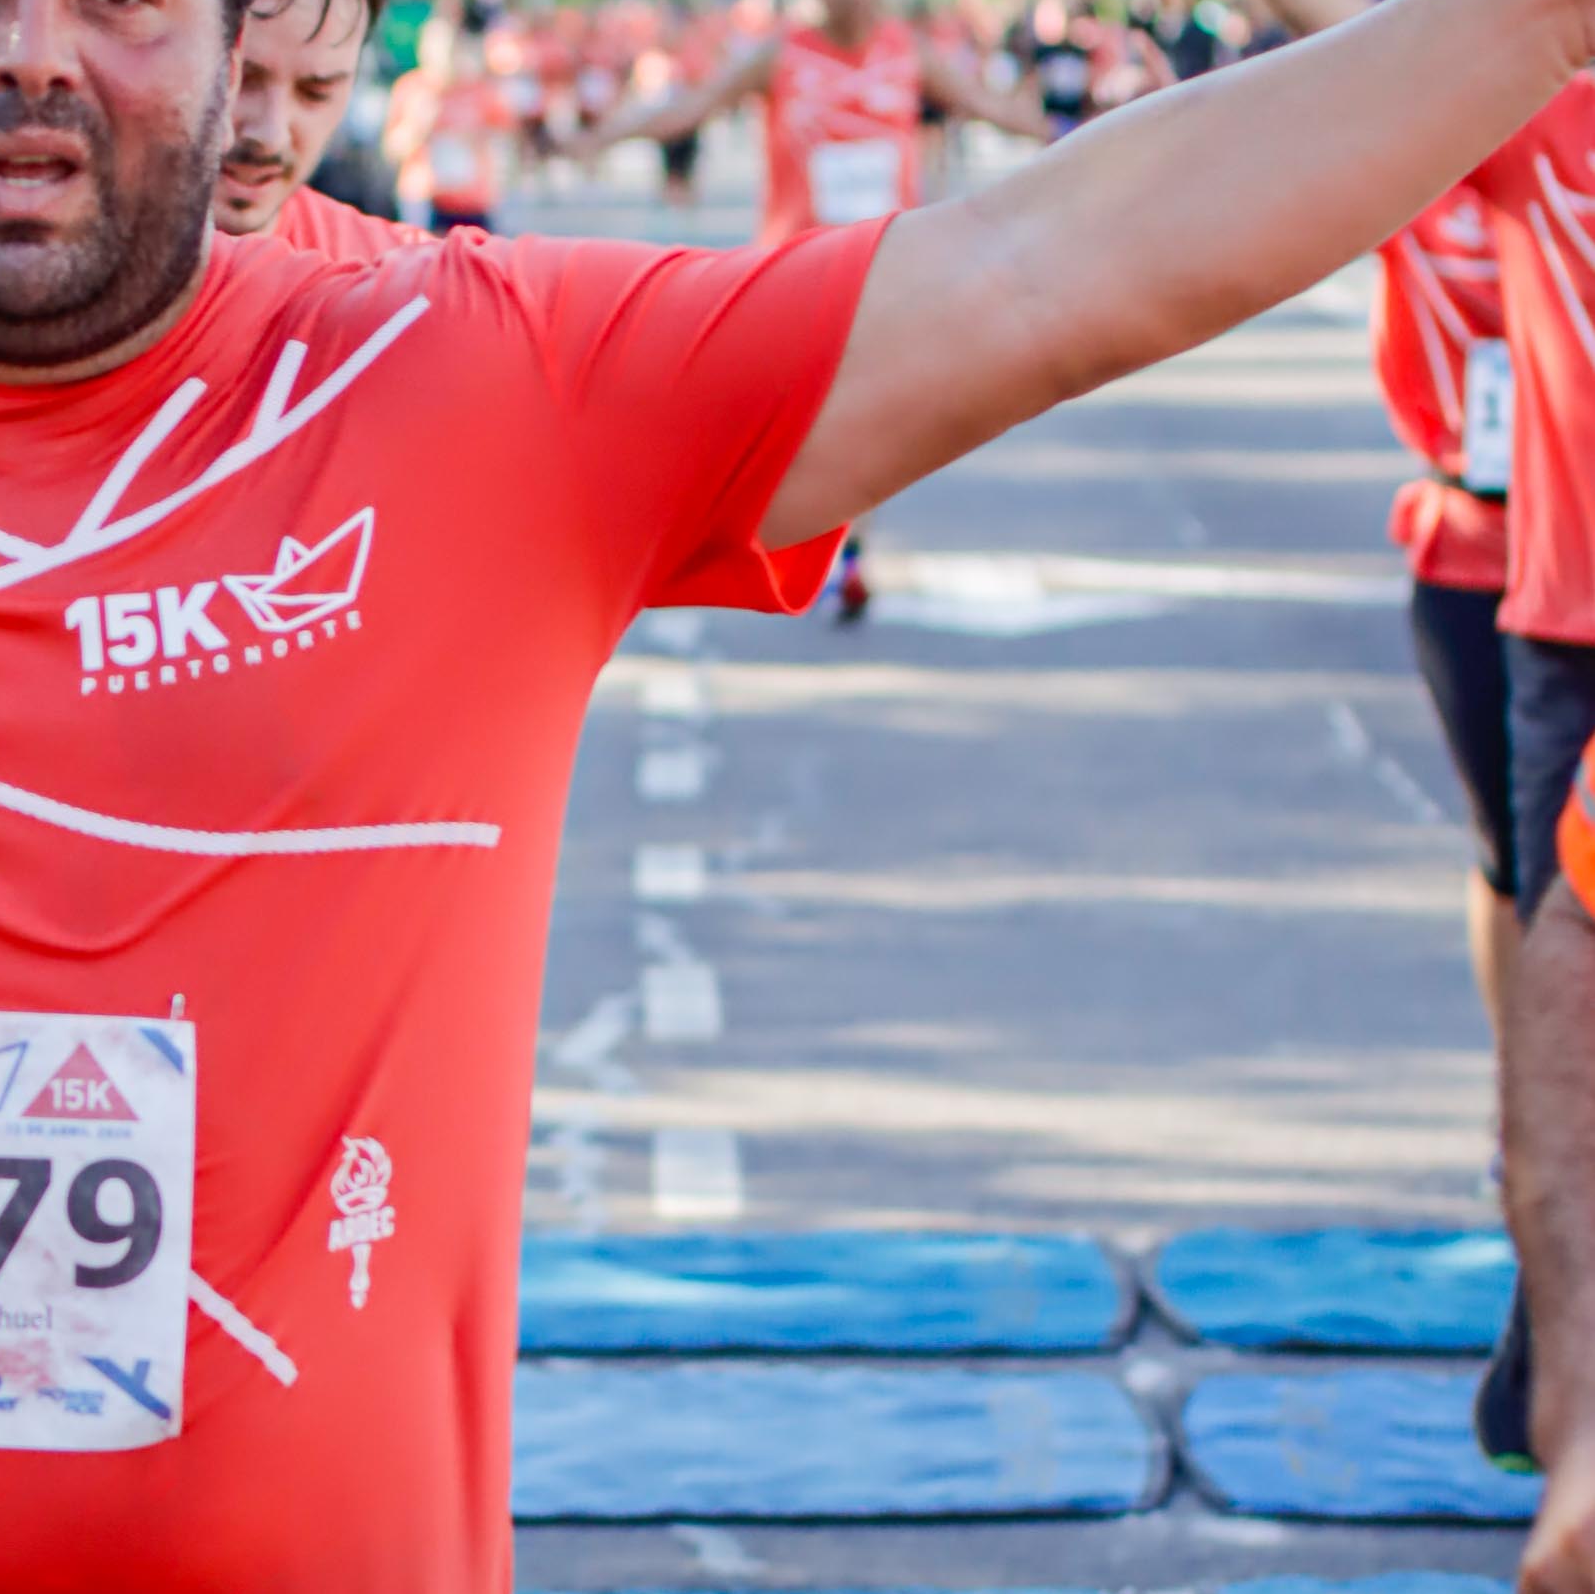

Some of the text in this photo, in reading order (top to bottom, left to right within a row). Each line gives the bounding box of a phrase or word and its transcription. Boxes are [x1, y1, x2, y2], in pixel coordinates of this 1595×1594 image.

[64, 581, 229, 672] 15K
[80, 610, 362, 696] PUERTO NORTE
[49, 1077, 114, 1112] 15K
